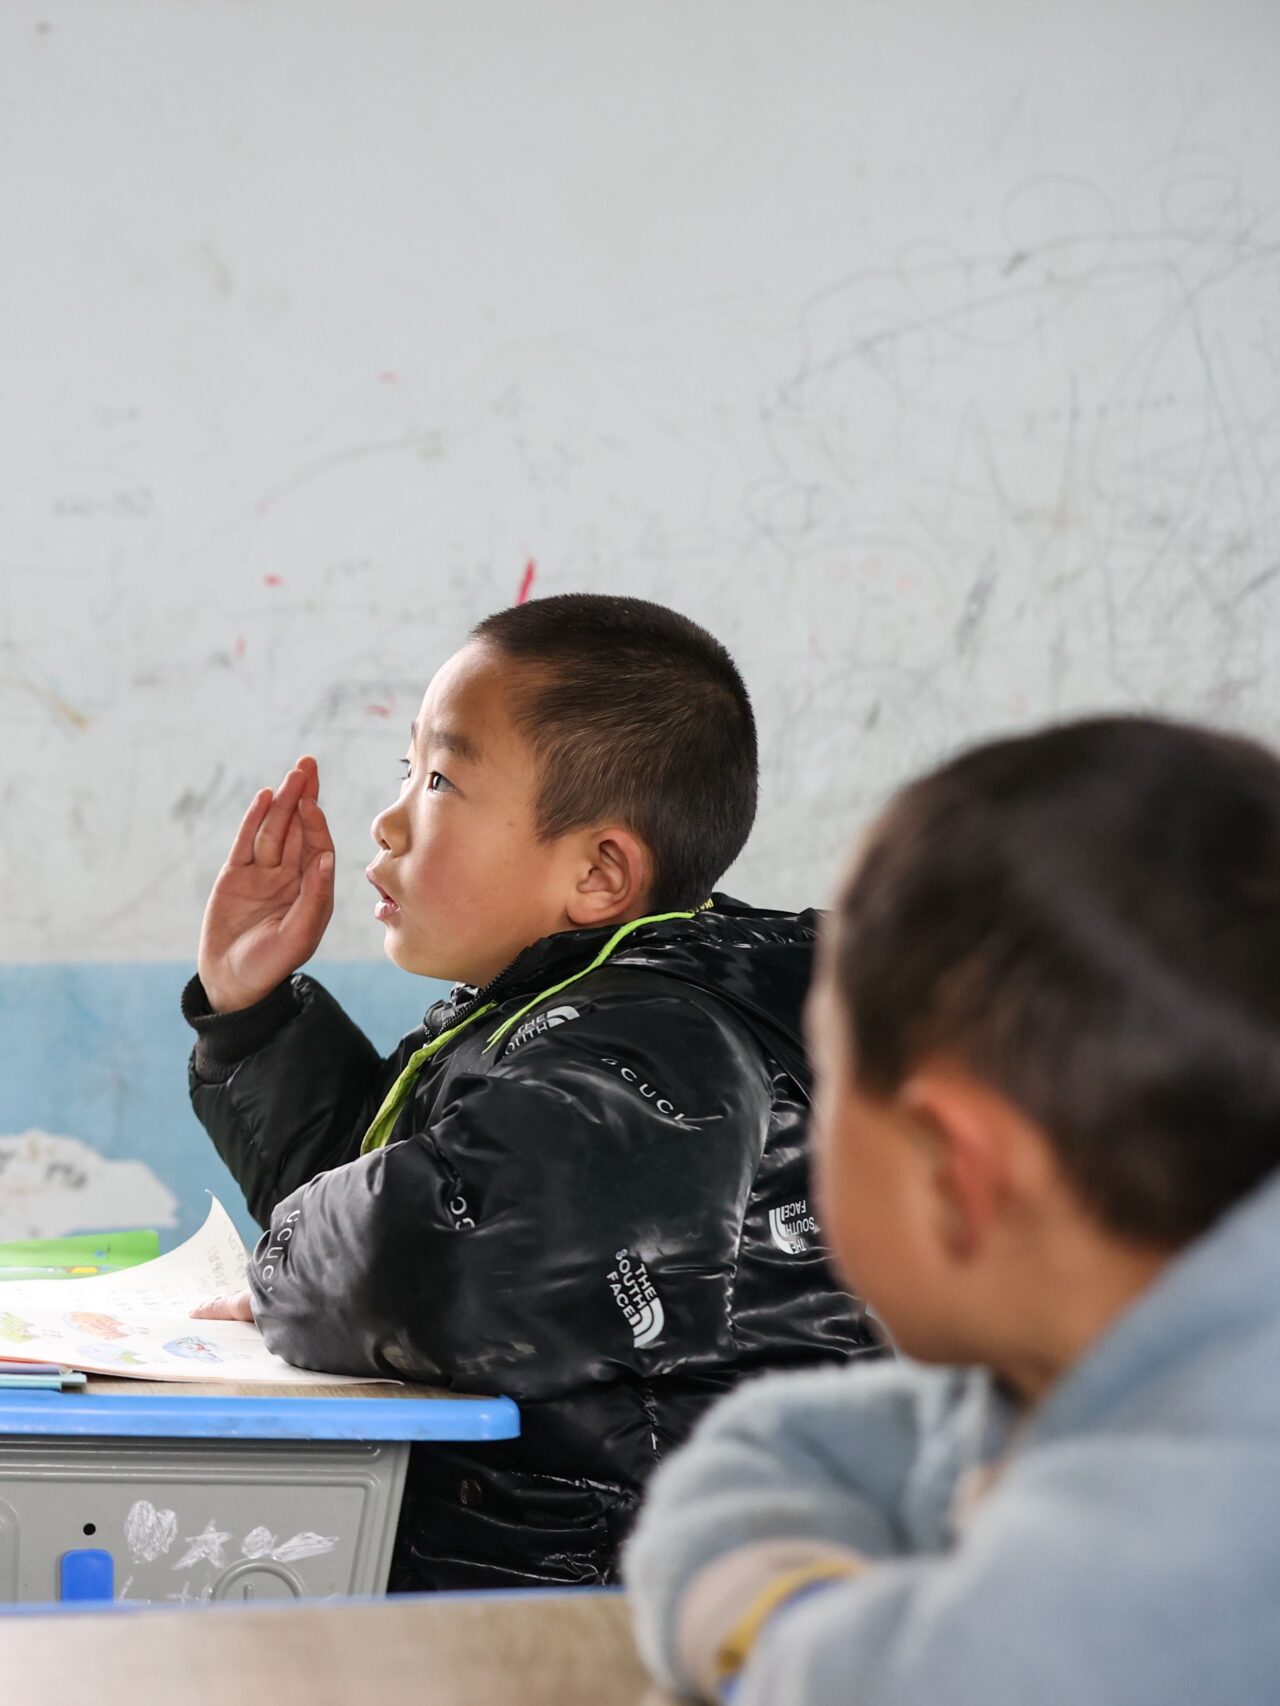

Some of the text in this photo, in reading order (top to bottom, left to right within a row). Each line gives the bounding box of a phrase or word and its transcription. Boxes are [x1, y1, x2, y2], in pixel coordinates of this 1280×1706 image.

[504, 1021, 548, 1056] OUTH
[783, 1199, 807, 1219] FACE
[785, 1216, 815, 1236] SOUTH
[606, 1270, 636, 1319] FACE
[615, 1248, 647, 1309] SOUTH
[635, 1263, 658, 1301] THE
